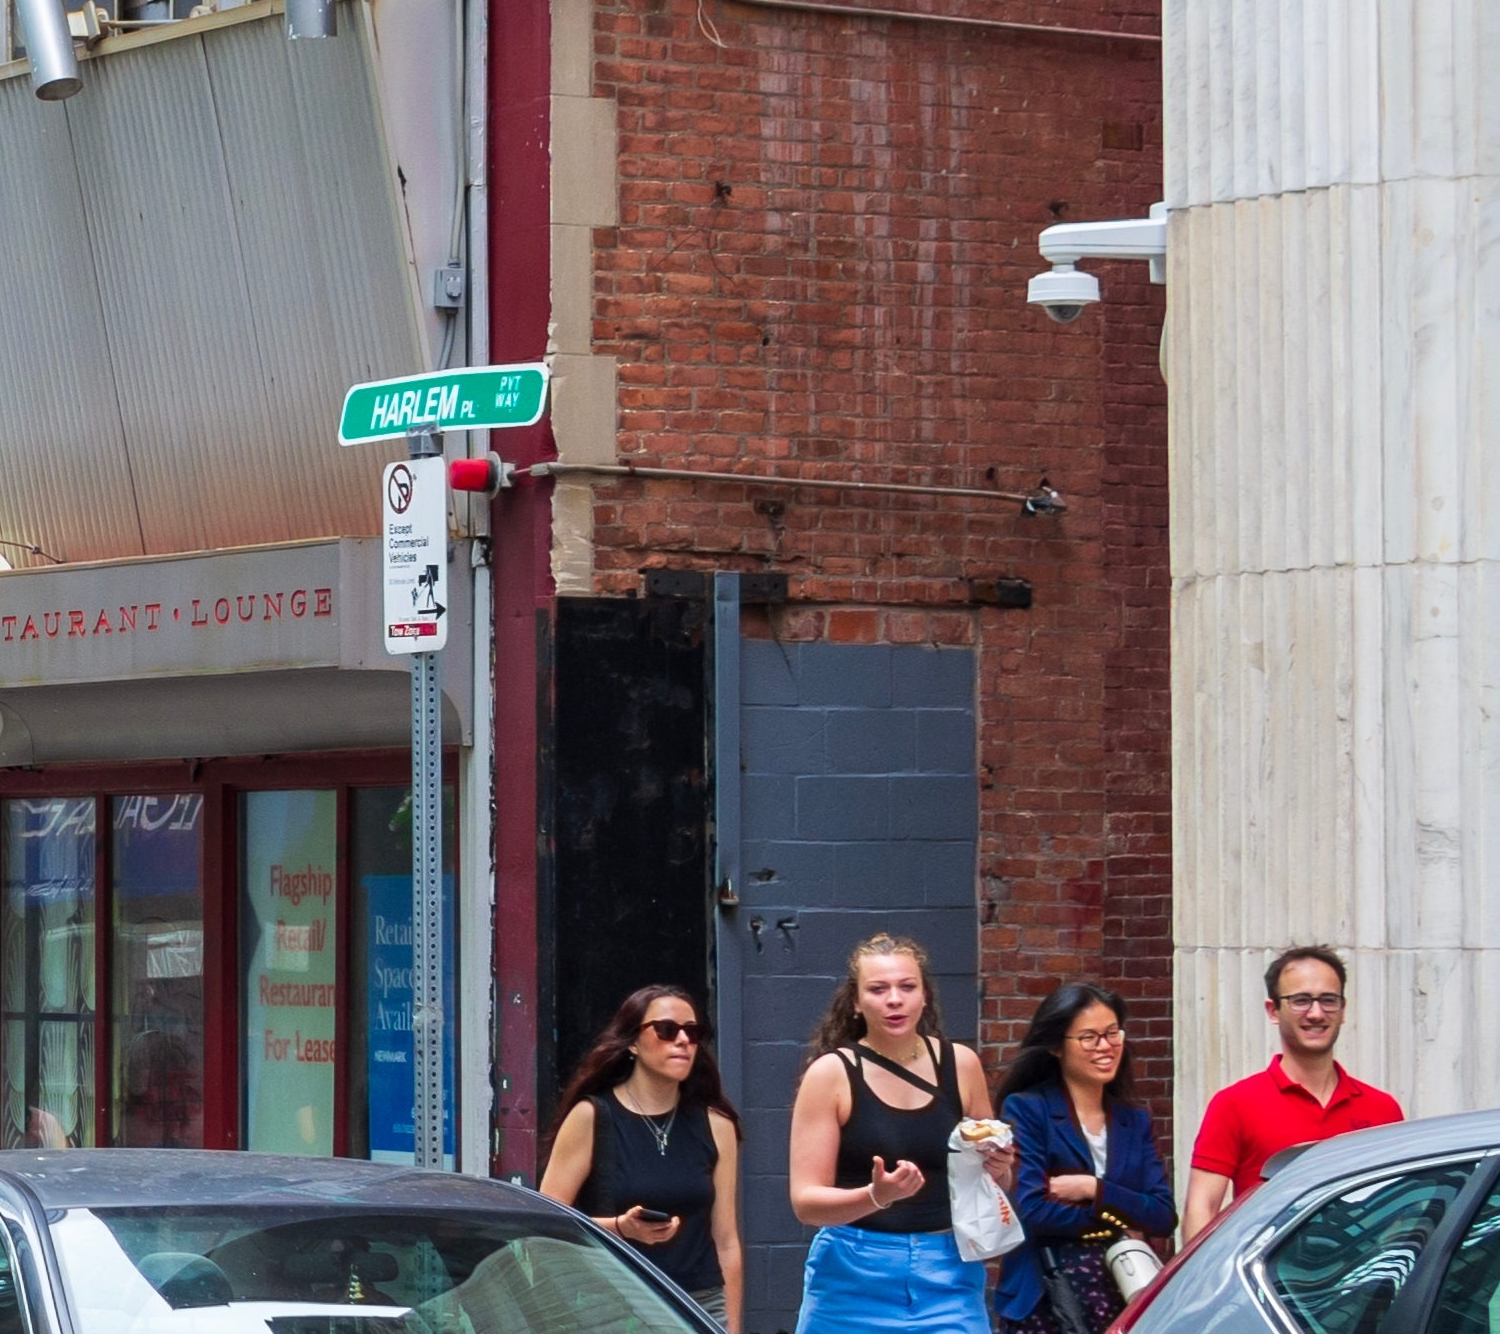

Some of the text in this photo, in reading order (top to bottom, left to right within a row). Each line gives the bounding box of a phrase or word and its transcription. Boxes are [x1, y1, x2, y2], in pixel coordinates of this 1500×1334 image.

[499, 375, 522, 391] PVT
[370, 384, 476, 429] HARLEM PL
[495, 392, 520, 408] WAY
[389, 524, 412, 536] Except
[389, 536, 429, 549] Commercial
[389, 550, 417, 563] Vehicles
[191, 588, 333, 627] LOUNGE
[390, 626, 403, 636] Tow
[269, 865, 332, 906] Flagship
[276, 919, 326, 952] Retail/
[375, 916, 413, 945] Retai
[259, 974, 335, 1007] Restauran
[264, 1029, 335, 1063] For Lease
[374, 1050, 406, 1063] NEWMARK
